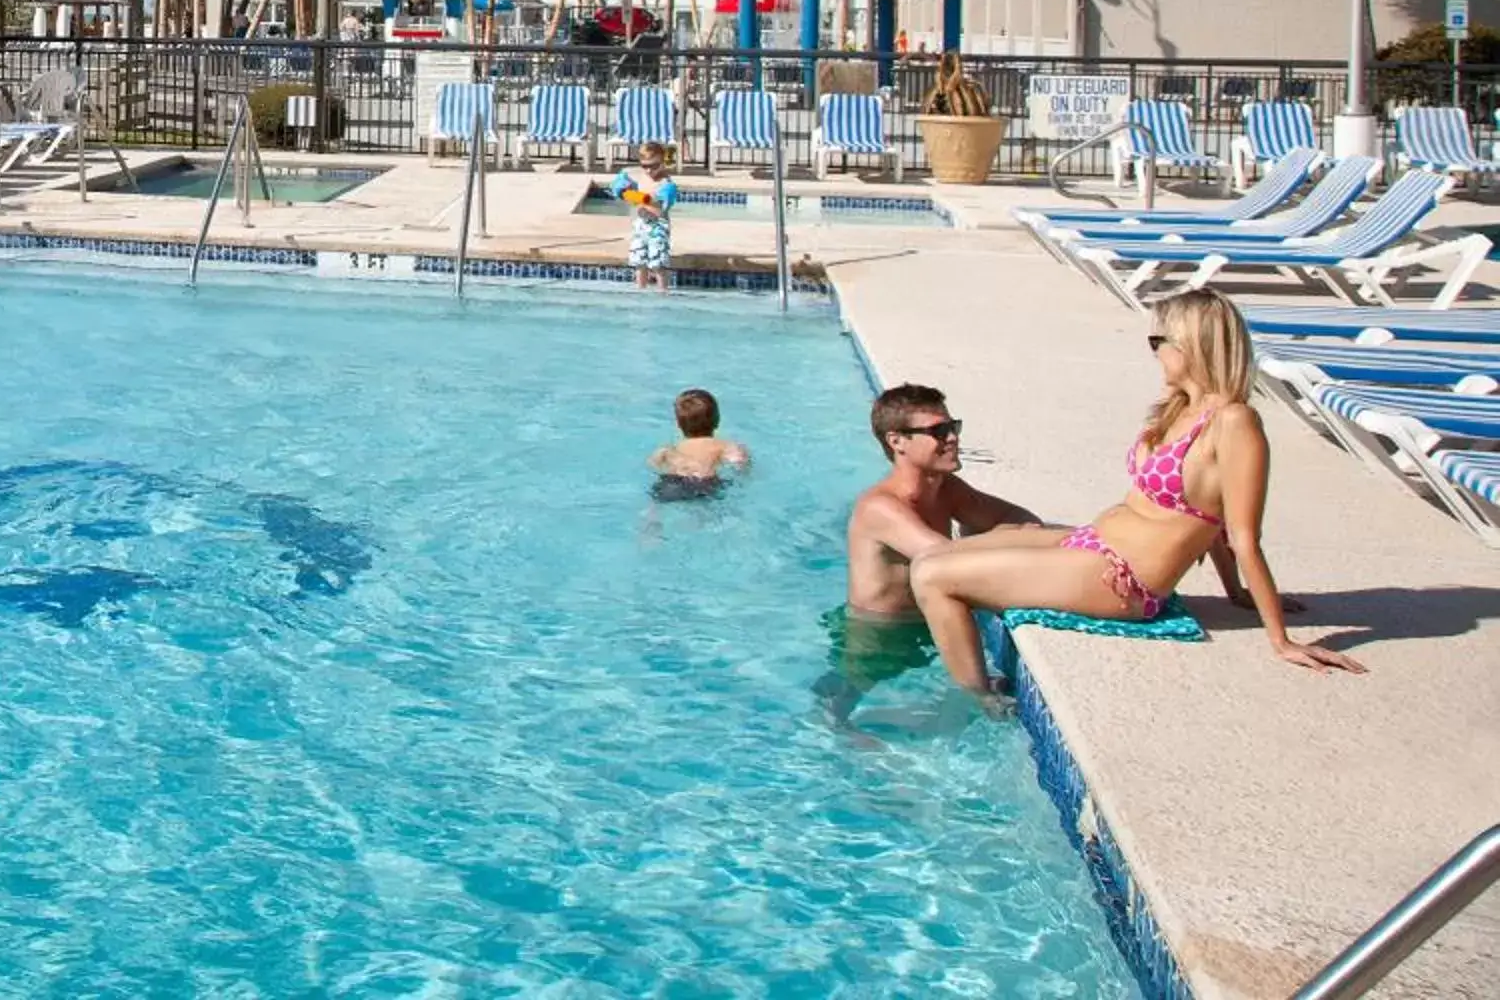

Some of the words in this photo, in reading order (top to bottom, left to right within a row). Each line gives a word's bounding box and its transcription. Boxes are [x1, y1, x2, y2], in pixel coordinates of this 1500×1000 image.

[1033, 79, 1051, 94] NO
[1056, 79, 1127, 95] LIFEGUARD
[1051, 96, 1069, 112] ON
[350, 252, 358, 268] 3
[368, 253, 387, 270] FT
